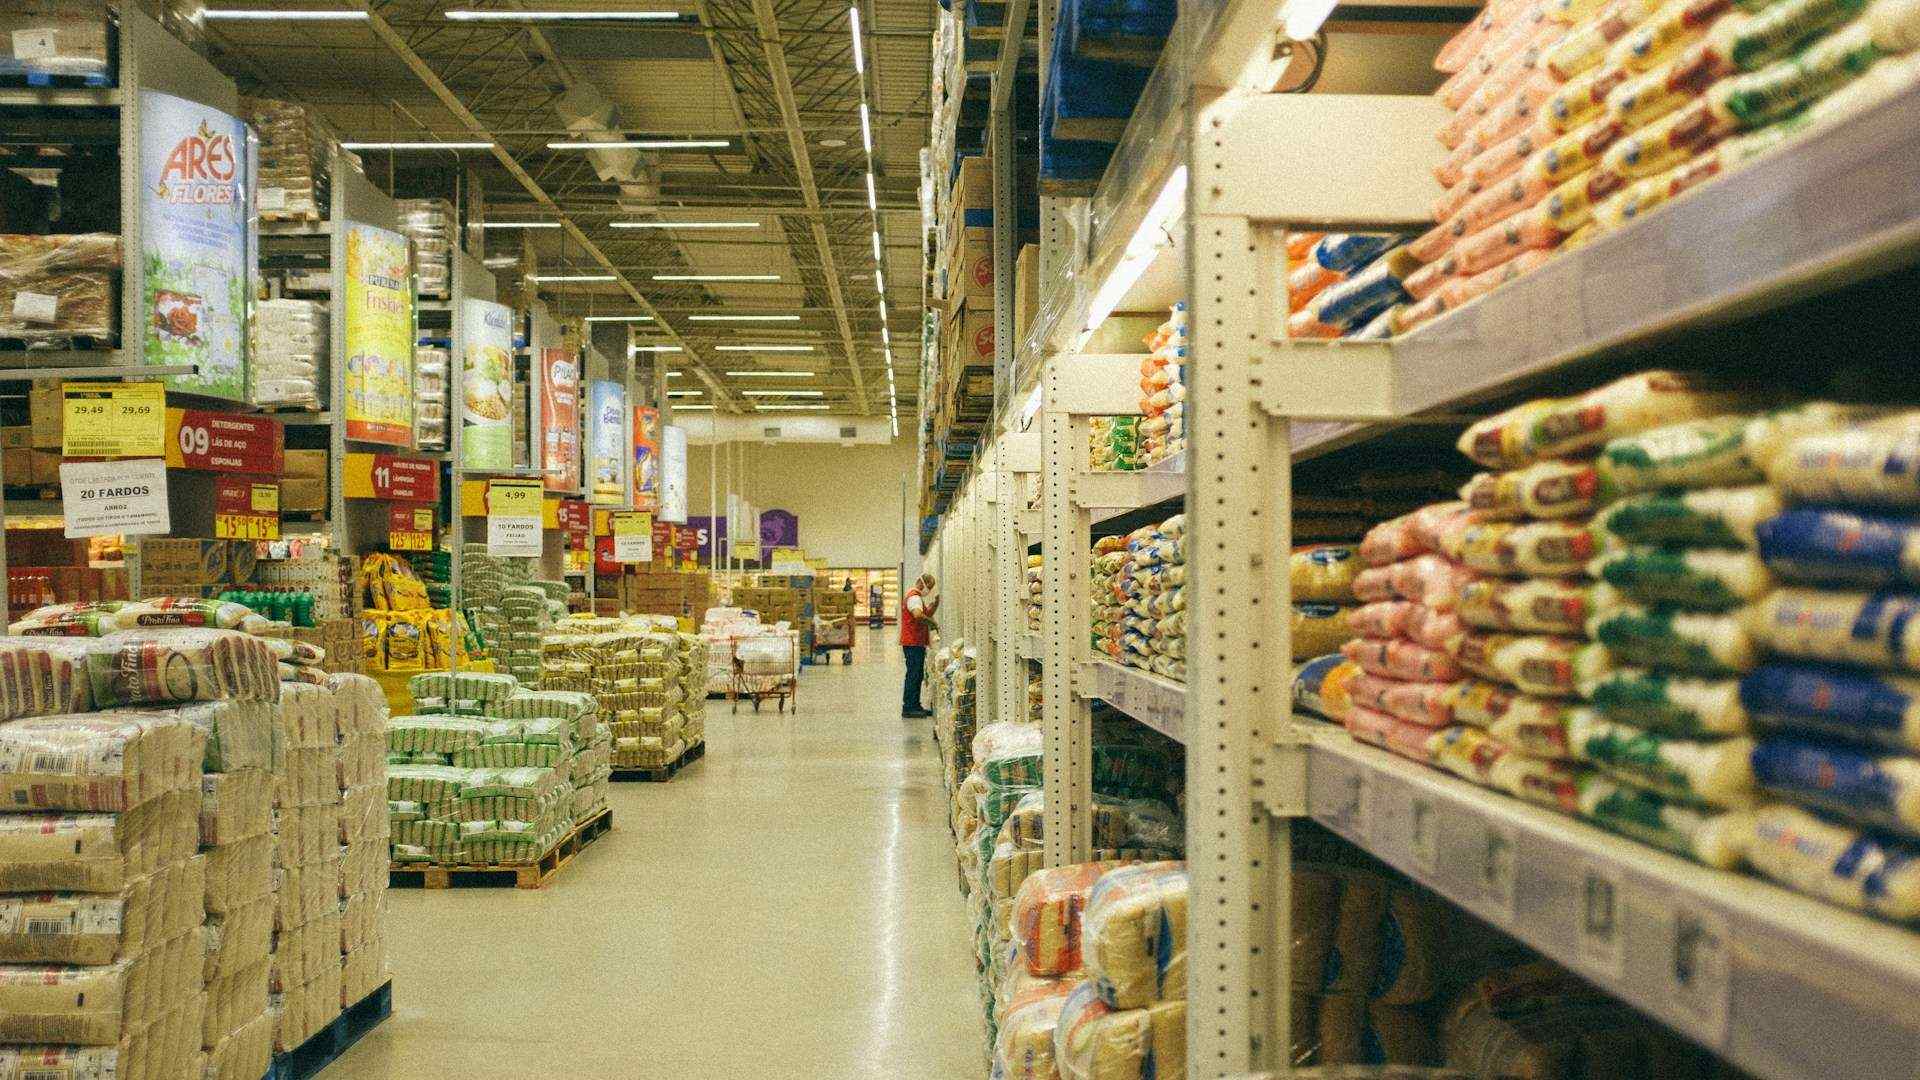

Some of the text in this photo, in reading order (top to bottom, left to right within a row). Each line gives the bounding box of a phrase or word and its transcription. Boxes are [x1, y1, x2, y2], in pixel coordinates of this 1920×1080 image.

[160, 135, 235, 181] ARES
[168, 185, 232, 205] FLORES
[74, 406, 104, 415] 29,49
[122, 406, 151, 415] 29,69
[179, 425, 210, 455] 09
[375, 467, 390, 488] 11
[80, 485, 150, 499] 20 FARDOS
[505, 491, 526, 500] 4,99
